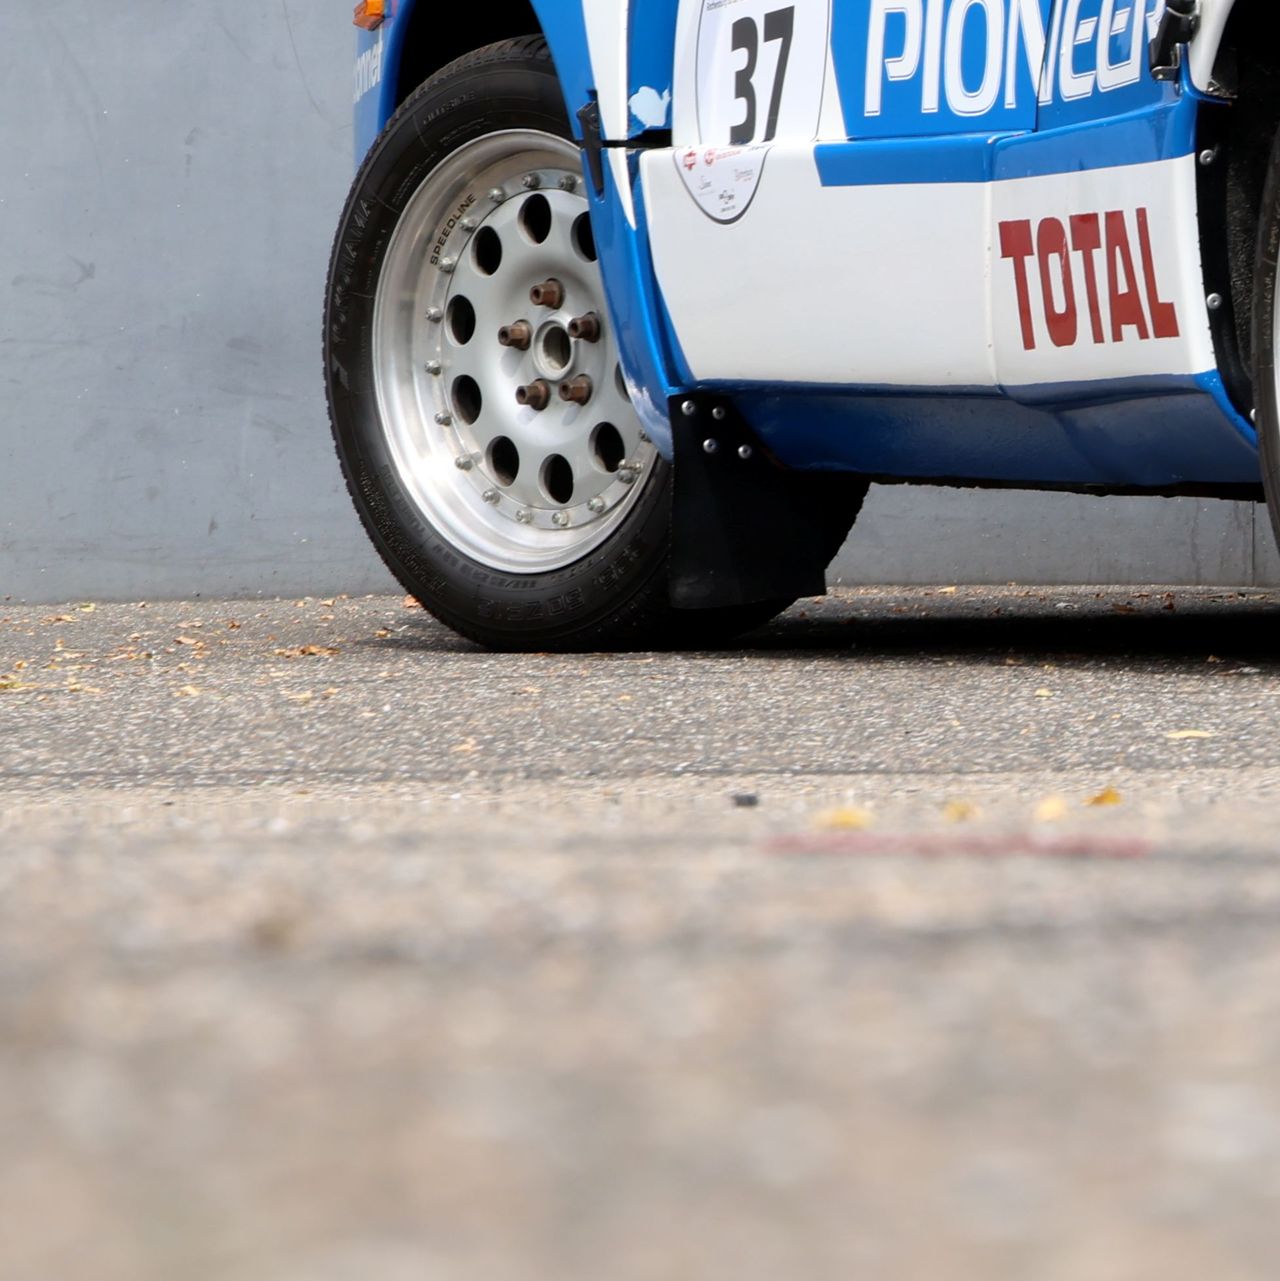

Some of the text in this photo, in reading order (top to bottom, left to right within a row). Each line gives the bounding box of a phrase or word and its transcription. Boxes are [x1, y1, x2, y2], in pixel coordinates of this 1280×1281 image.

[729, 5, 795, 146] 37
[430, 193, 476, 266] SPEEDLINE
[998, 207, 1180, 351] TOTAL
